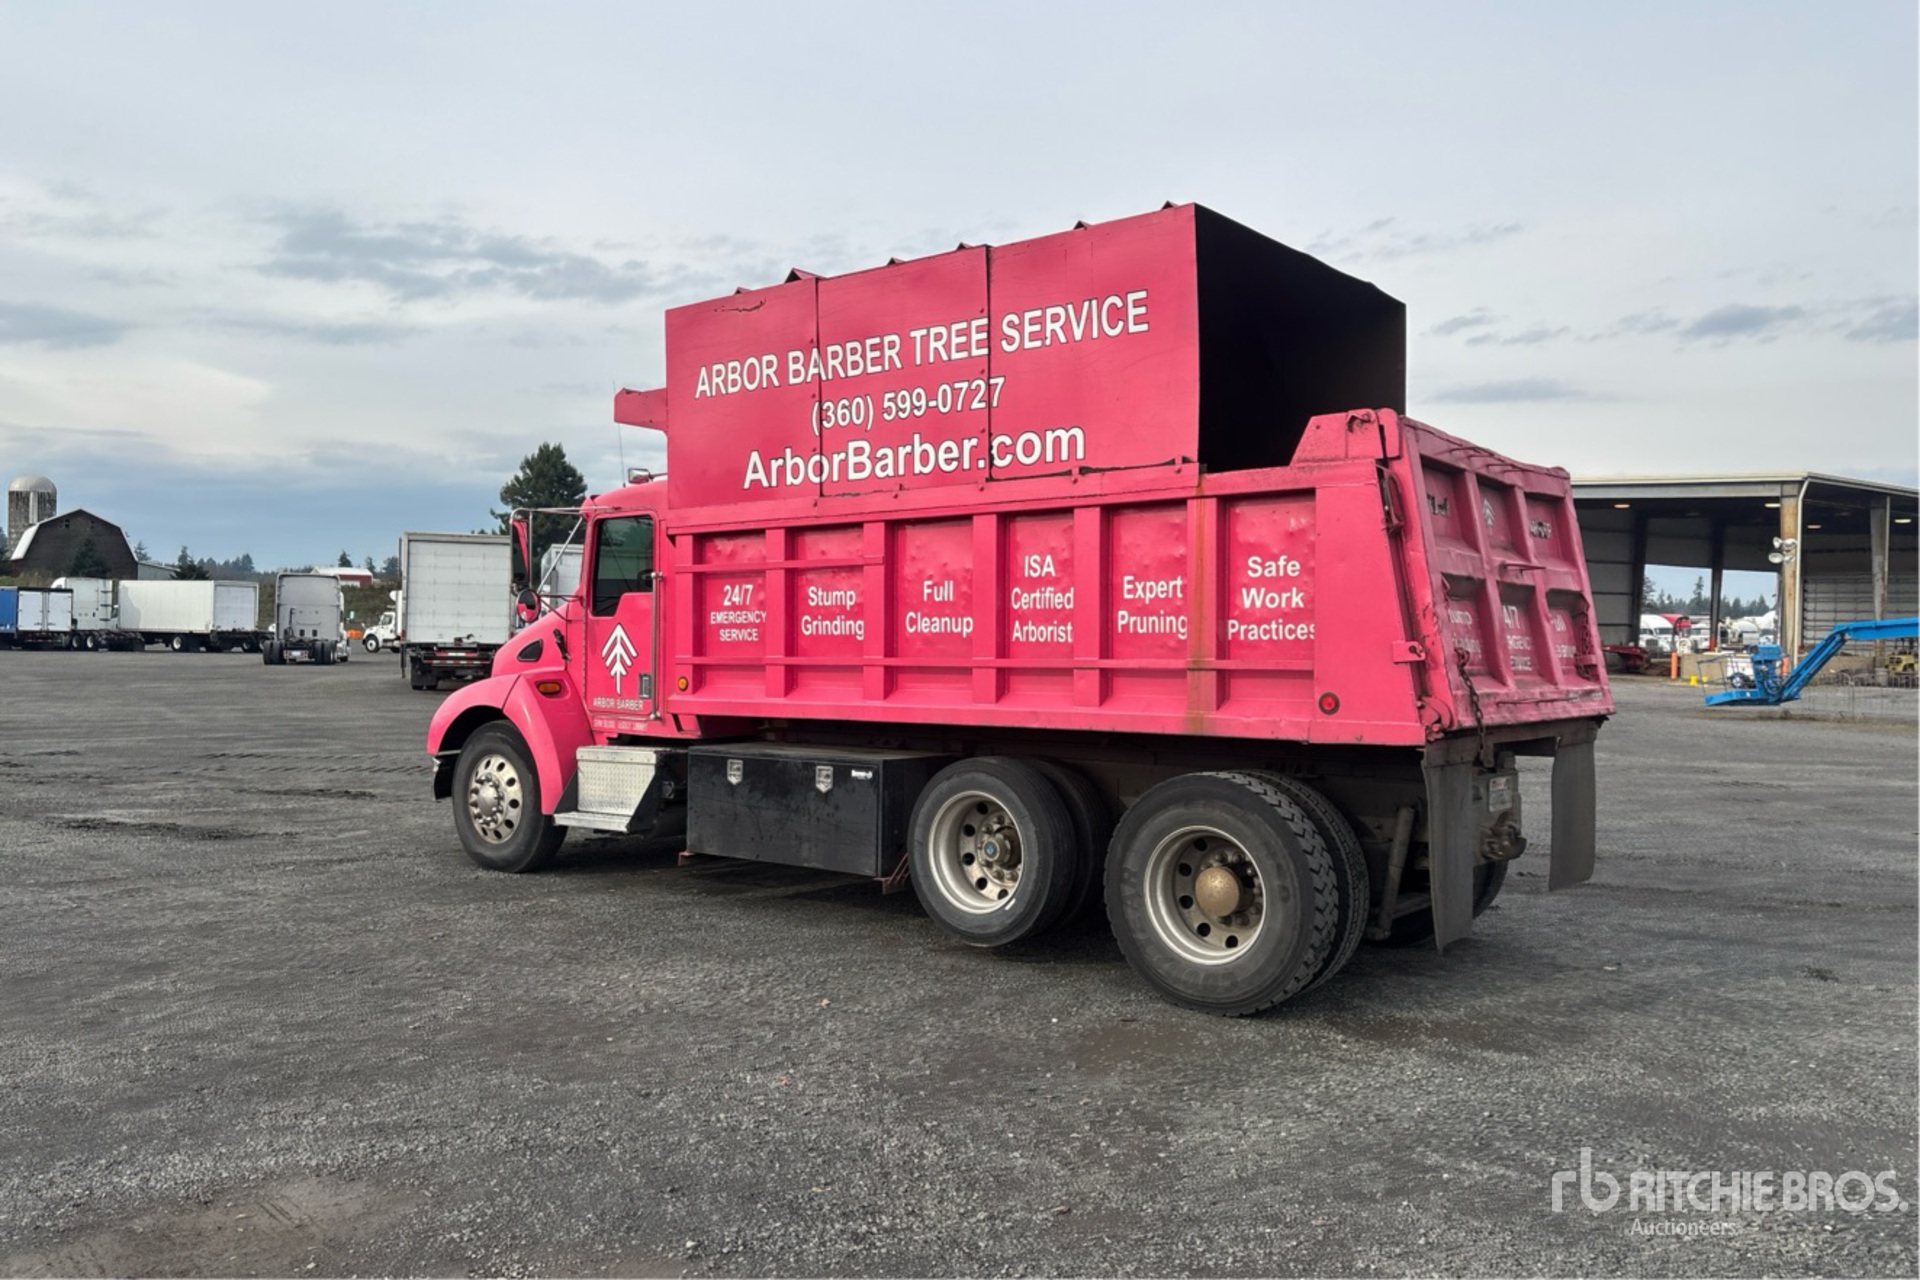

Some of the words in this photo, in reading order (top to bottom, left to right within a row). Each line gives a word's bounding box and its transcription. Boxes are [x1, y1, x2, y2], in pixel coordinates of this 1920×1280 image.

[695, 353, 780, 399] ARBOR
[787, 334, 902, 385] BARBER
[909, 317, 989, 365] TREE
[1000, 290, 1149, 352] SERVICE
[812, 395, 874, 436] (360)
[883, 376, 1005, 421] 599-0727
[743, 425, 1085, 489] ArborBarber.com
[1024, 554, 1056, 578] ISA
[1247, 555, 1301, 578] Safe
[723, 584, 754, 606] 24/7
[808, 585, 856, 610] Stump
[923, 580, 953, 602] Full
[1011, 586, 1074, 610] Certified
[1123, 575, 1183, 604] Expert
[1241, 586, 1304, 609] Work
[710, 610, 766, 624] EMERGENCY
[801, 615, 864, 641] Grinding
[905, 611, 974, 638] Cleanup
[1117, 610, 1188, 640] Pruning
[719, 628, 758, 641] SERVICE
[1012, 620, 1073, 643] Arborist
